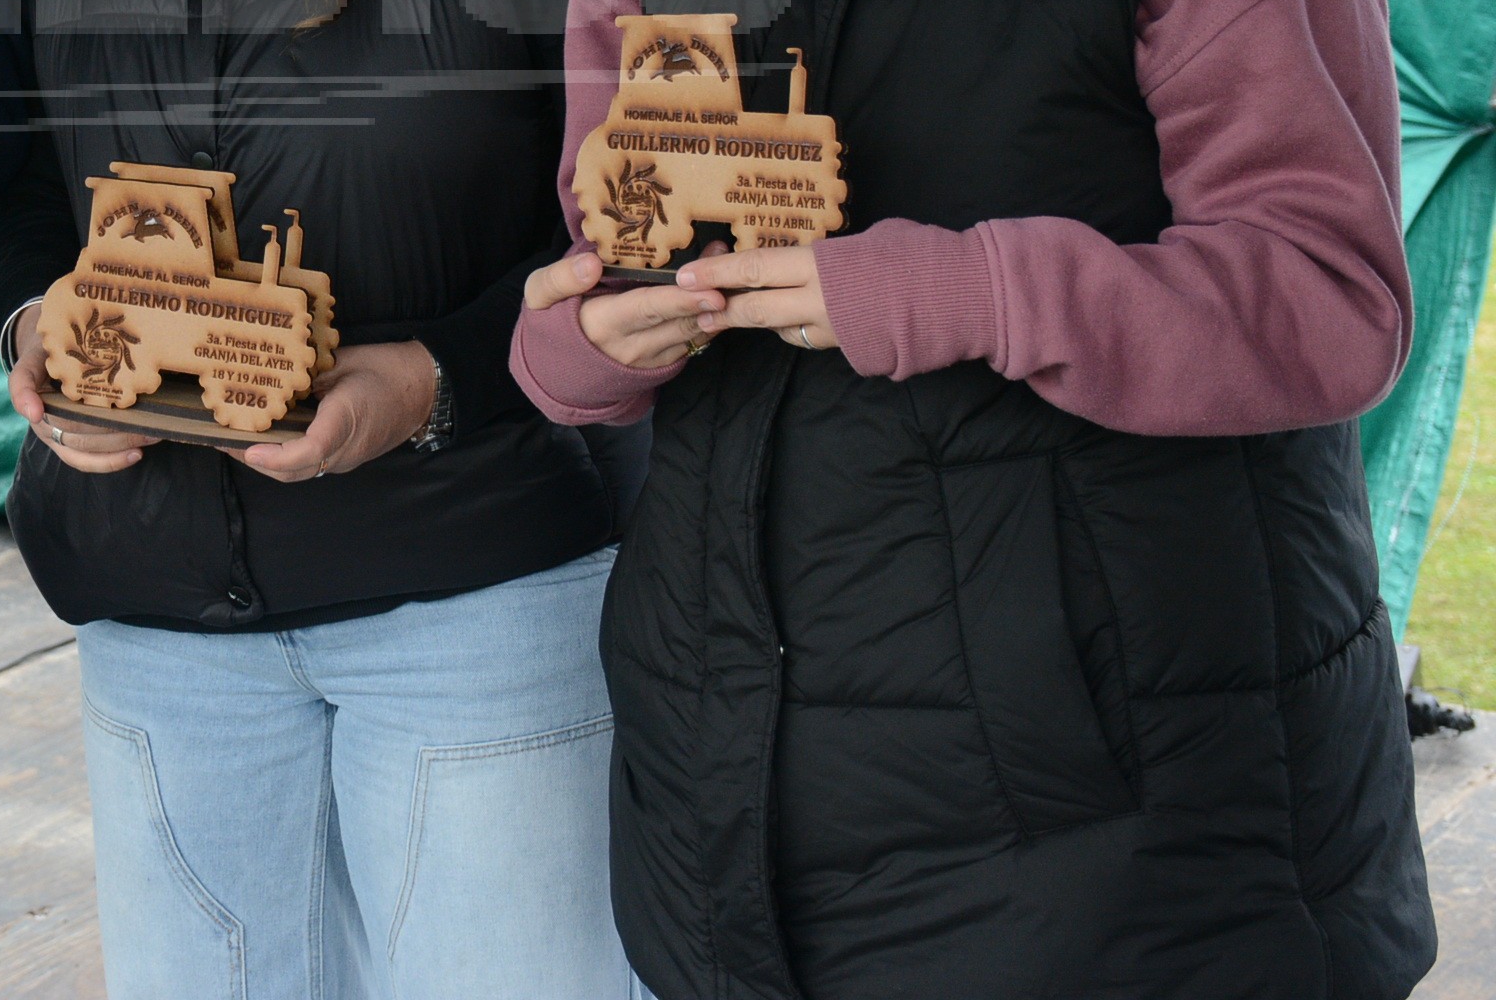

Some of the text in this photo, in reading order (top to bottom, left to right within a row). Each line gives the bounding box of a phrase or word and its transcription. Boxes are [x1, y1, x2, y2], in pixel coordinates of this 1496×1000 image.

[627, 37, 730, 83] JOHN DEERE
[624, 110, 738, 126] HOMENAJE AL SEÑOR
[607, 133, 823, 162] GUILLERMO RODRIGUEZ
[736, 176, 816, 192] 3a. Fiesta de la
[725, 192, 826, 210] GRANJA DEL AYER
[97, 203, 139, 237] JOHN
[164, 206, 203, 249] DEERE
[743, 215, 816, 231] 18 Y 19 ABRIL
[93, 263, 210, 289] HOMENAJE AL SEÑOR
[75, 283, 180, 312] GUILLERMO
[186, 300, 293, 329] RODRIGUEZ
[207, 334, 285, 355] 3a. Fiesta de la
[194, 346, 294, 372] GRANJA DEL AYER
[212, 369, 283, 389] 18 Y 19 ABRIL
[224, 390, 268, 410] 2026
